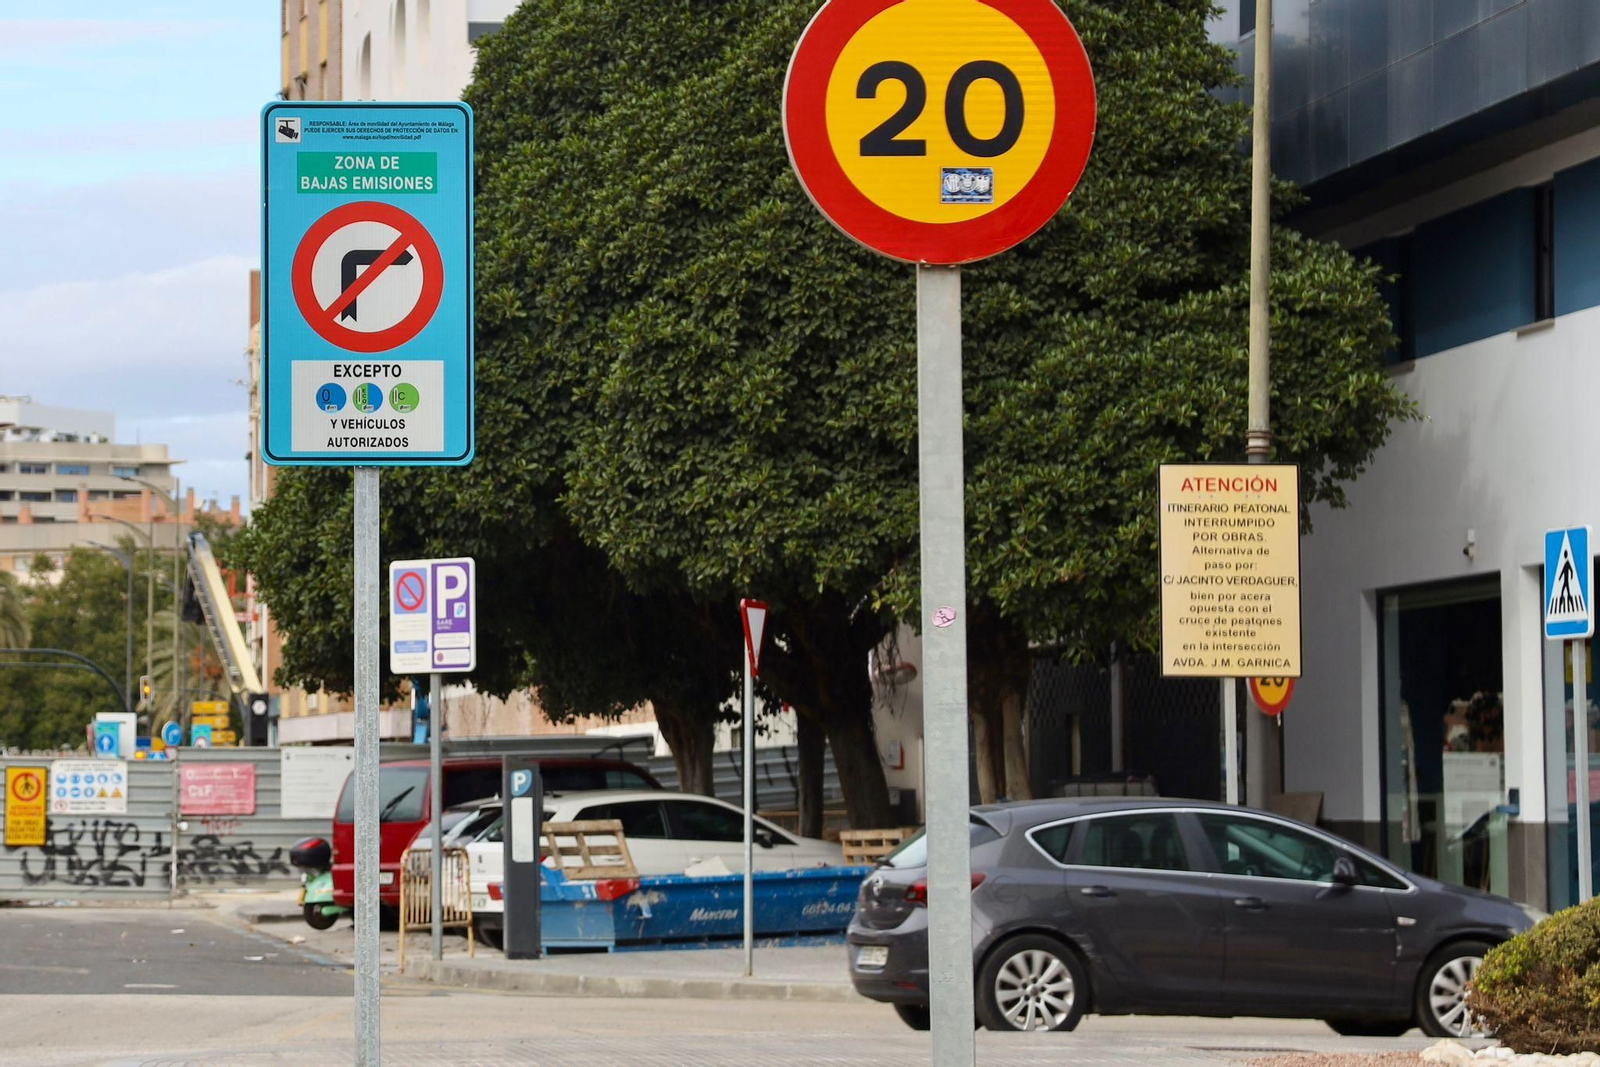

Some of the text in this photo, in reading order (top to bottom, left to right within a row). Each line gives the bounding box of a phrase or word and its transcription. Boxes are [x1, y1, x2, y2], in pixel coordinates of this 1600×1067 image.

[856, 60, 1025, 158] 20
[334, 156, 400, 170] ZONA DE
[301, 176, 434, 190] BAJAS EMISIONES
[333, 364, 402, 378] EXCEPTO
[331, 416, 406, 430] Y VEHÍCULOS
[327, 437, 409, 448] AUTORIZADOS
[1181, 474, 1278, 492] ATENCIÓN
[1167, 503, 1291, 514] ITINERARIO PEATONAL
[1184, 518, 1275, 528] INTERRUMPIDO
[1192, 532, 1267, 542] POR OBRAS.
[1192, 545, 1270, 556] Alternativa de
[1204, 562, 1258, 572] paso por:
[1163, 575, 1298, 587] C/ JACINTO VERDAGUER,
[436, 565, 468, 620] P
[1190, 590, 1214, 600] bien
[1218, 593, 1236, 602] por
[1190, 604, 1234, 614] opuesta
[1262, 604, 1272, 613] el
[1179, 616, 1282, 627] cruce de peatones
[1205, 628, 1256, 637] existente
[1200, 642, 1209, 651] la
[1212, 642, 1281, 651] intersección
[1172, 658, 1292, 668] AVDA. J.M. GARNICA
[513, 772, 527, 792] P
